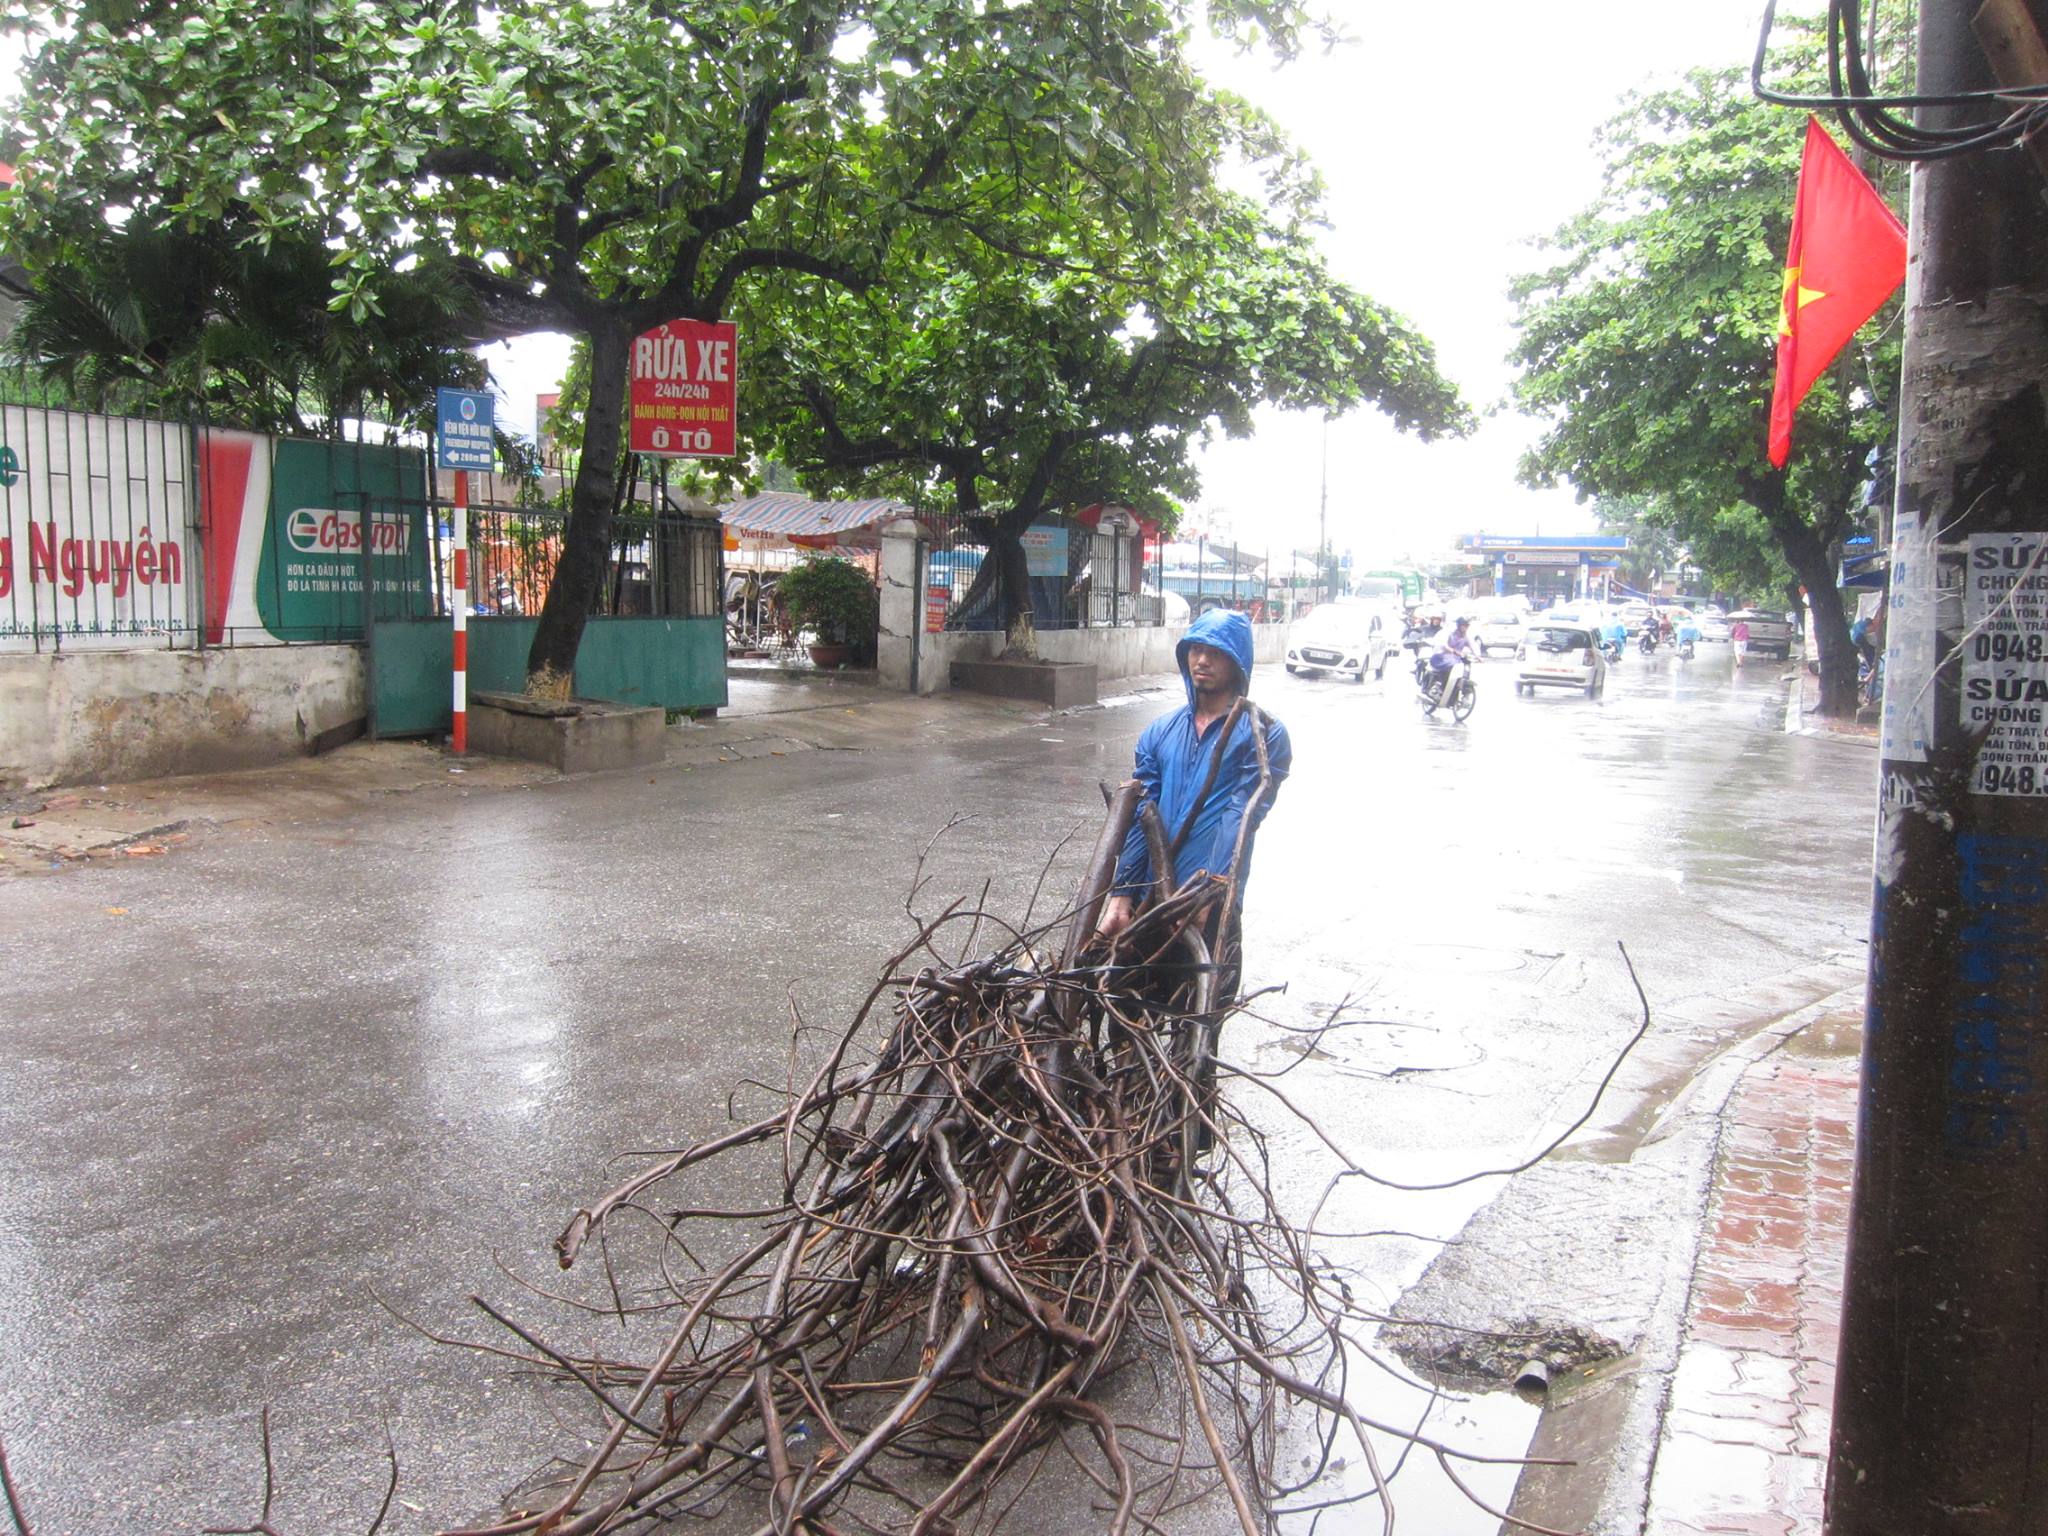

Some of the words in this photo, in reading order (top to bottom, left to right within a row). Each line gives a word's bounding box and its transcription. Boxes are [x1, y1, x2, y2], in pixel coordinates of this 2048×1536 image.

[635, 324, 688, 381] RỬA
[696, 340, 730, 382] XE
[655, 383, 710, 400] 24h/24h
[652, 426, 670, 448] Ô
[678, 428, 712, 450] TÔ
[28, 520, 182, 598] Nguyên
